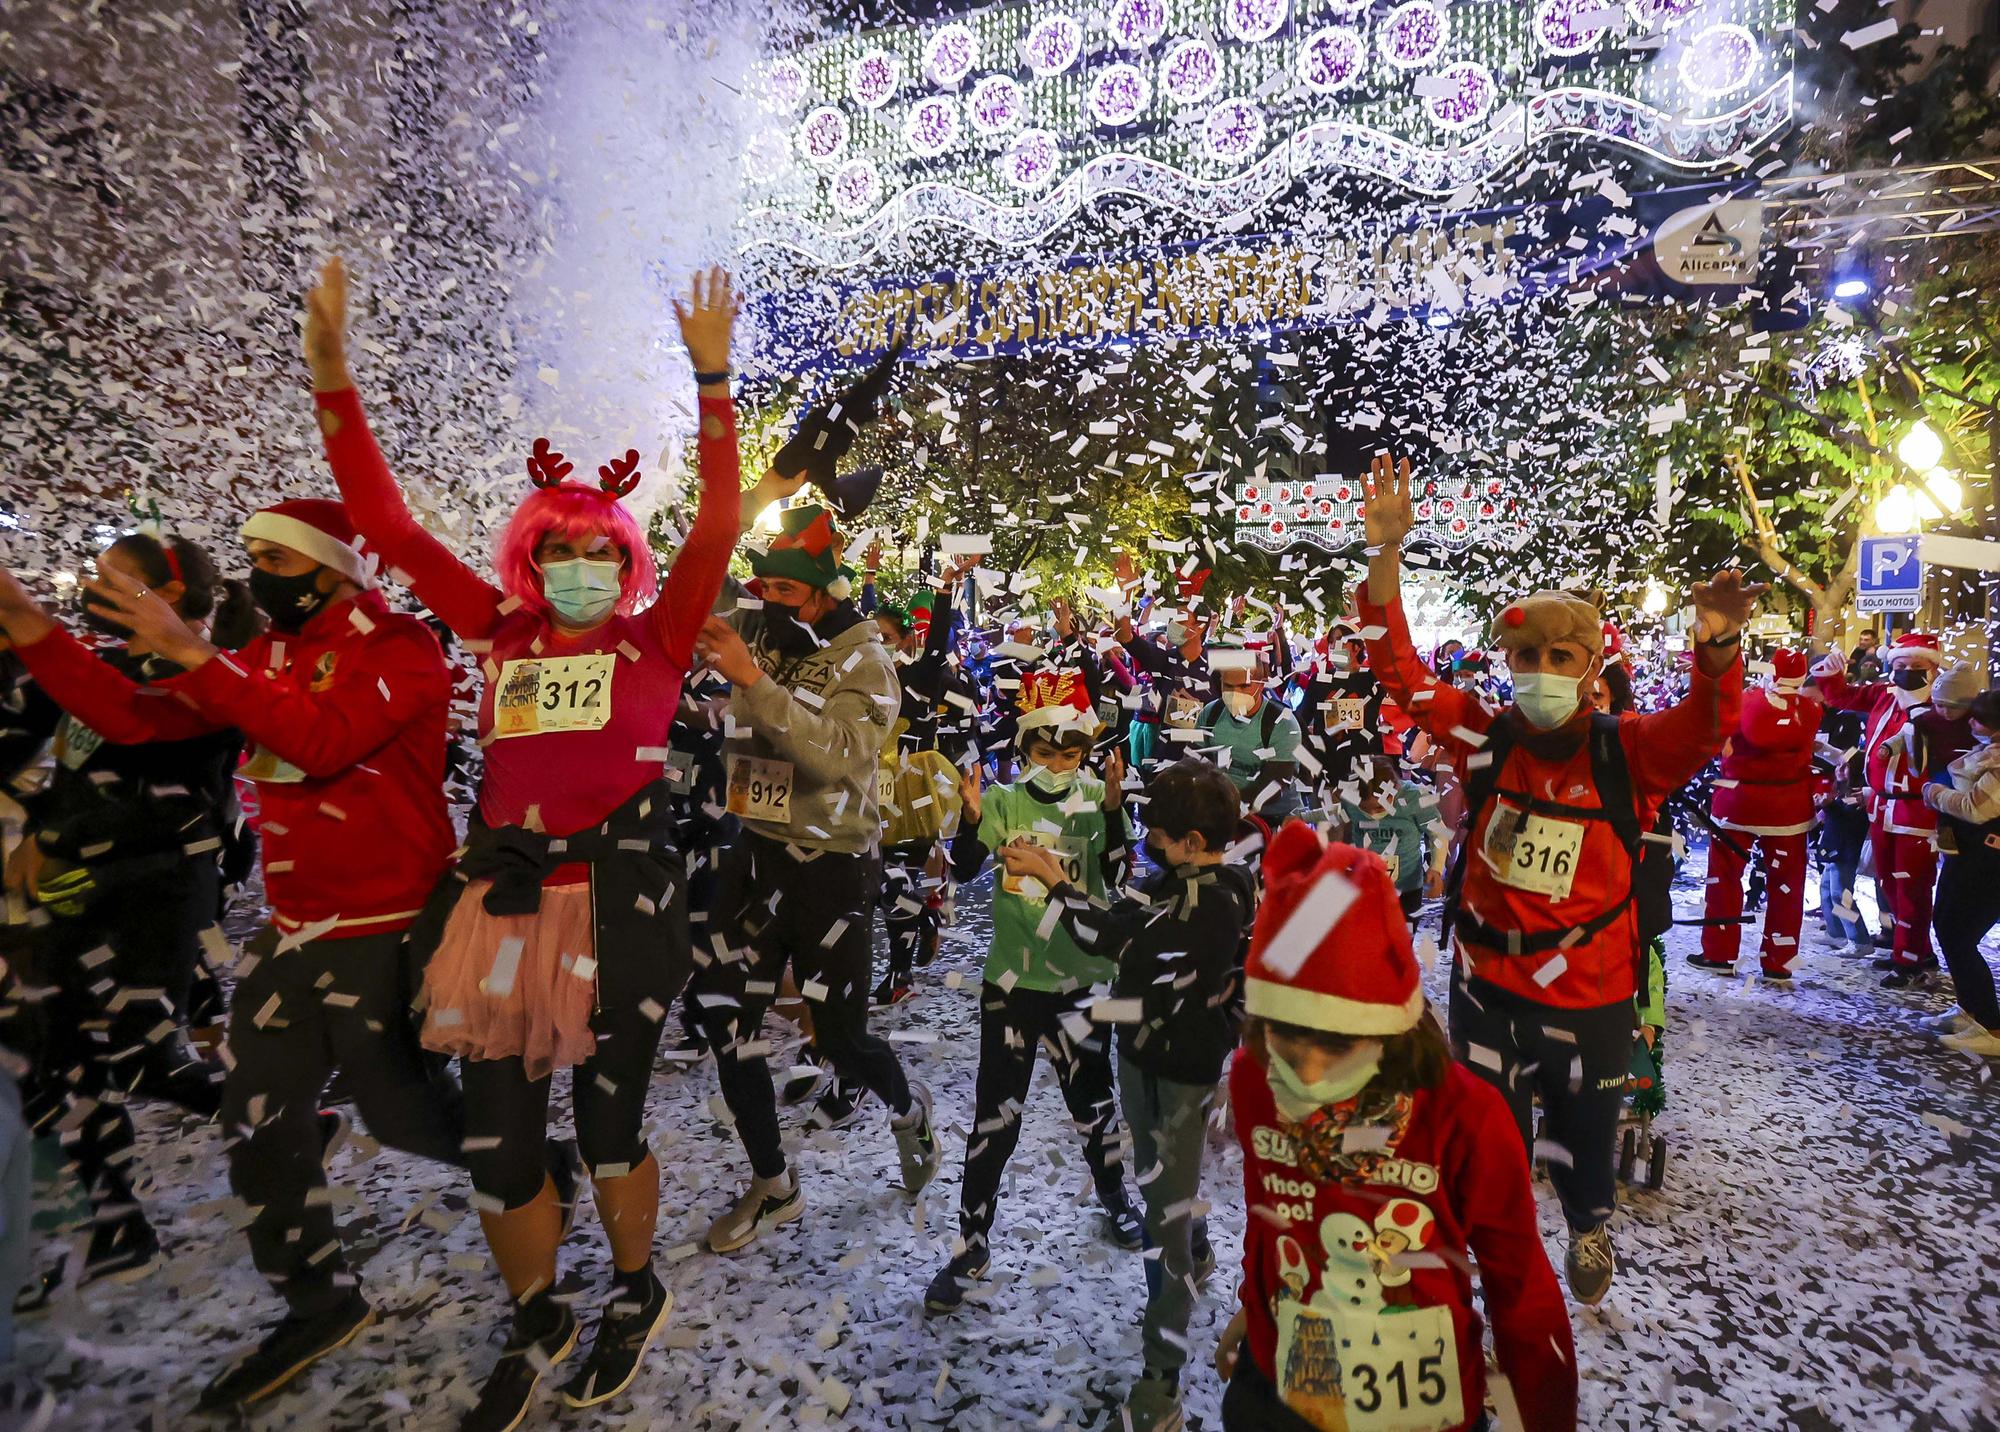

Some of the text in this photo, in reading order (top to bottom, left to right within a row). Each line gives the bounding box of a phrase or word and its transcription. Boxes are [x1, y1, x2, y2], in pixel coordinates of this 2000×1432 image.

[1872, 543, 1908, 586] P
[1862, 597, 1915, 607] SOLO MOTOS
[542, 678, 602, 711] 312
[1340, 710, 1361, 721] 313
[751, 781, 788, 808] 912
[1516, 842, 1571, 875] 316
[1351, 1355, 1447, 1413] 315
